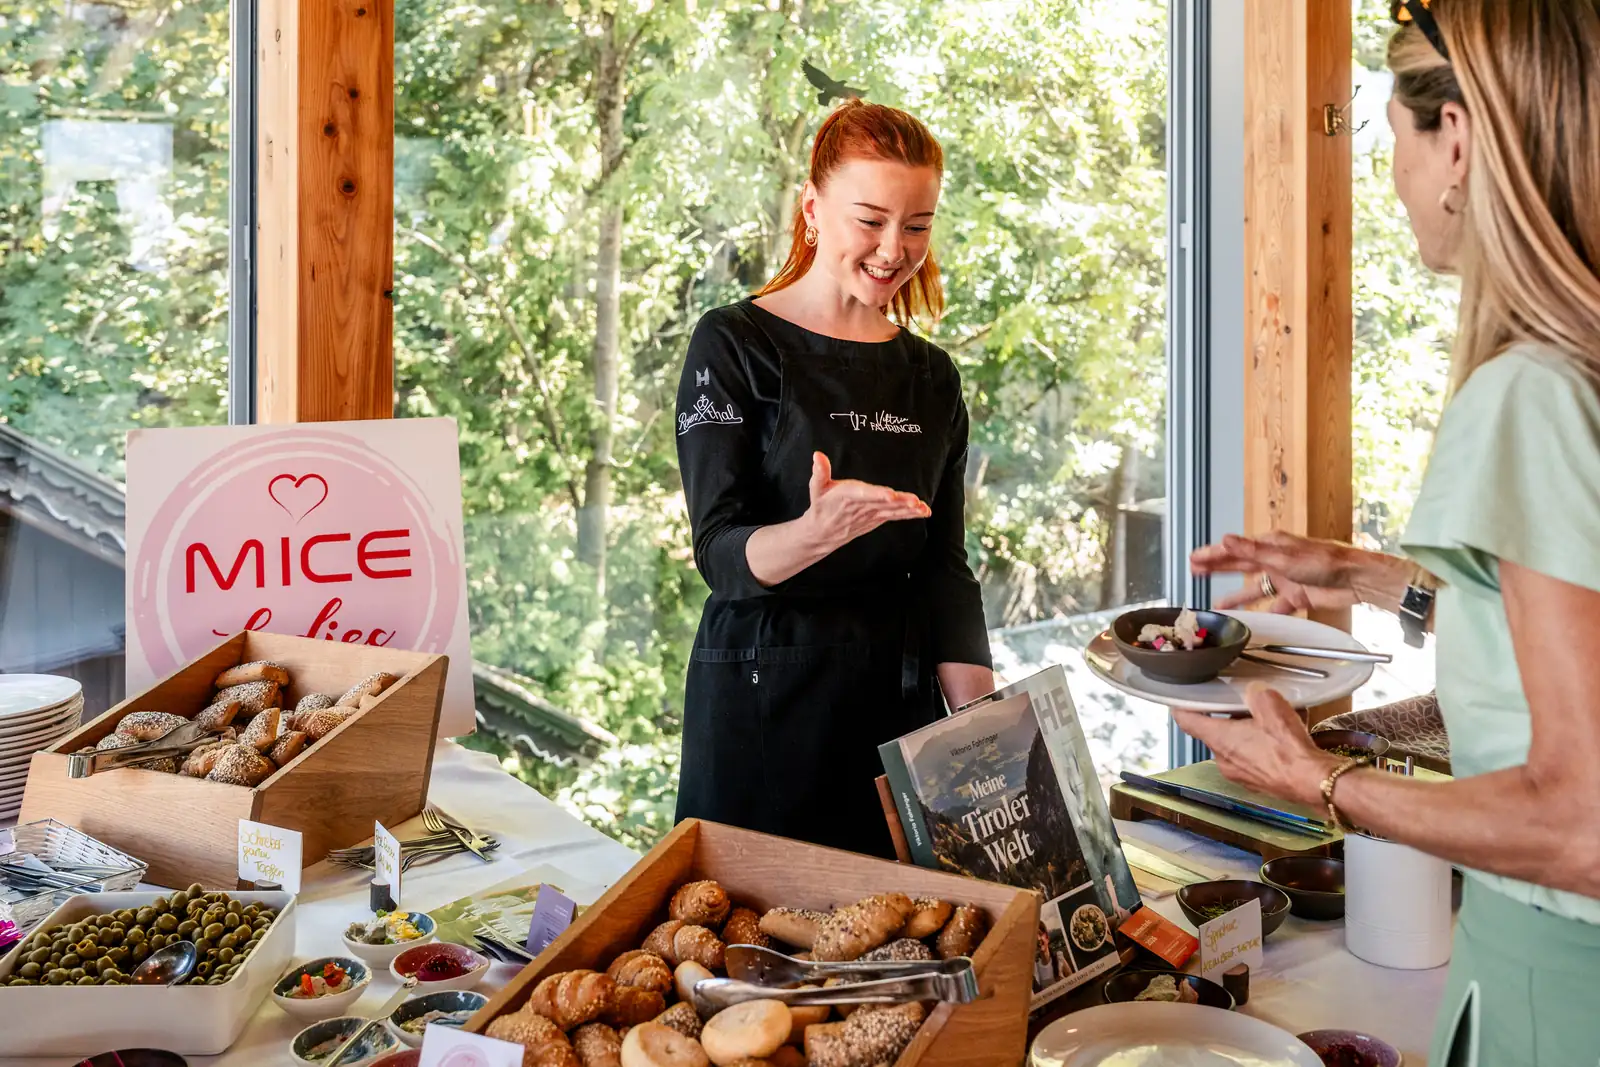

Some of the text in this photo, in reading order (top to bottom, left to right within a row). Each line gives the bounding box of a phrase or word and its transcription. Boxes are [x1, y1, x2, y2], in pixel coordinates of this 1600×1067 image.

[870, 421, 922, 433] FAHRINGER
[185, 528, 412, 593] MICE
[950, 733, 999, 757] Viktoria Fahringer
[969, 774, 1007, 802] Meine
[961, 794, 1031, 843] Tiroler
[983, 828, 1035, 873] Welt
